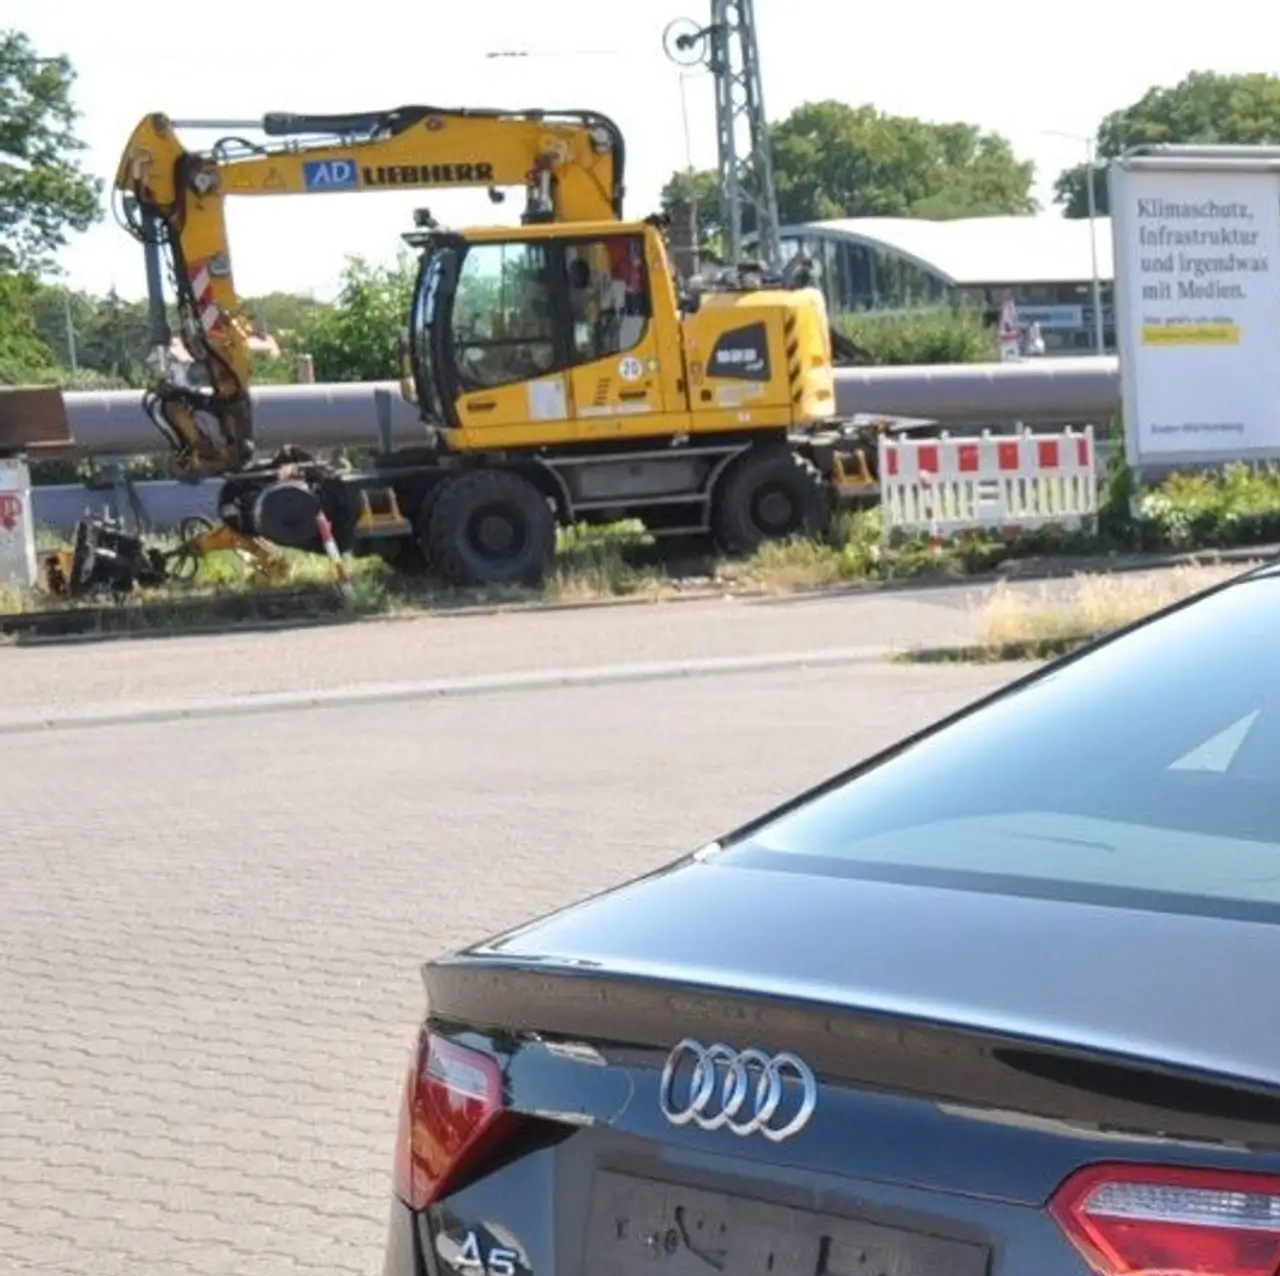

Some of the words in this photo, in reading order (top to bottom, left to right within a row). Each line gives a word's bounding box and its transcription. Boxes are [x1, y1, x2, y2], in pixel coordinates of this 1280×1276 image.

[313, 162, 349, 184] AD
[362, 163, 494, 185] LIEBHERR
[1137, 198, 1255, 222] Klimaschutz,
[1139, 225, 1259, 246] Infrastruktur
[1141, 252, 1174, 272] und
[1178, 251, 1269, 278] irgendwas
[1142, 281, 1171, 300] mit
[1178, 280, 1247, 300] Medien.
